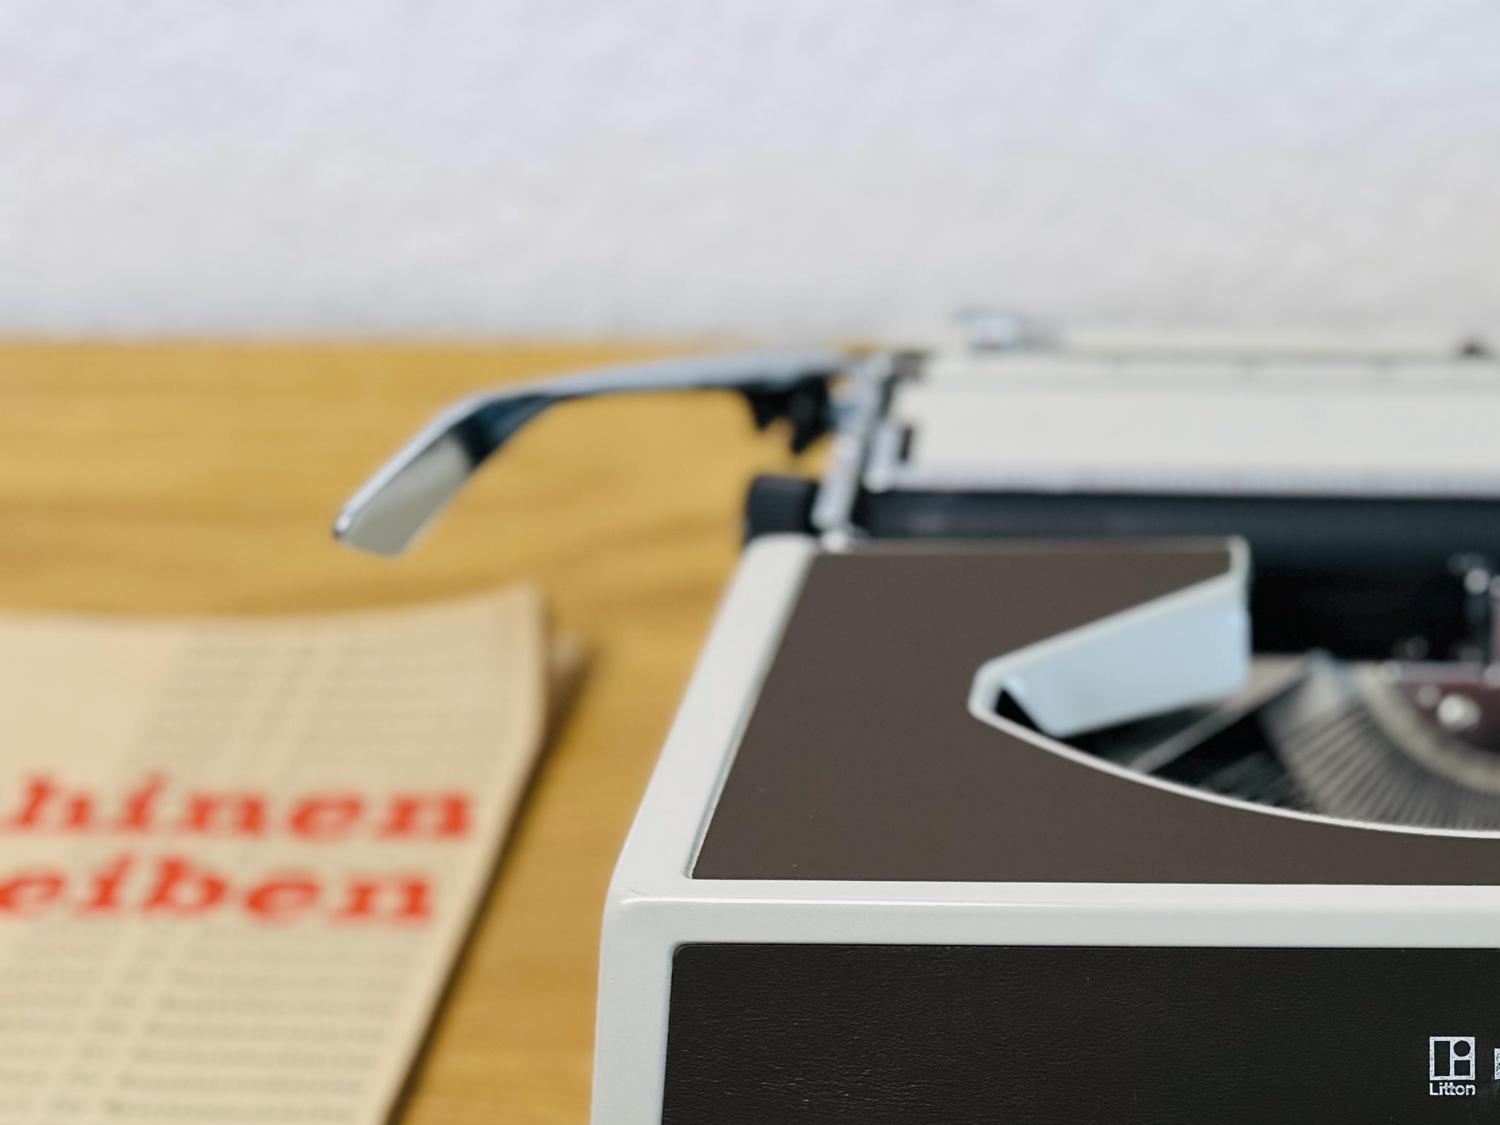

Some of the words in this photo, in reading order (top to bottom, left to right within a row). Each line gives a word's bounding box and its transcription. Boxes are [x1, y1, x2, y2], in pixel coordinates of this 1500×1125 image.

[0, 772, 473, 840] hinen
[0, 855, 435, 926] eiben
[1429, 1082, 1476, 1096] Litton
